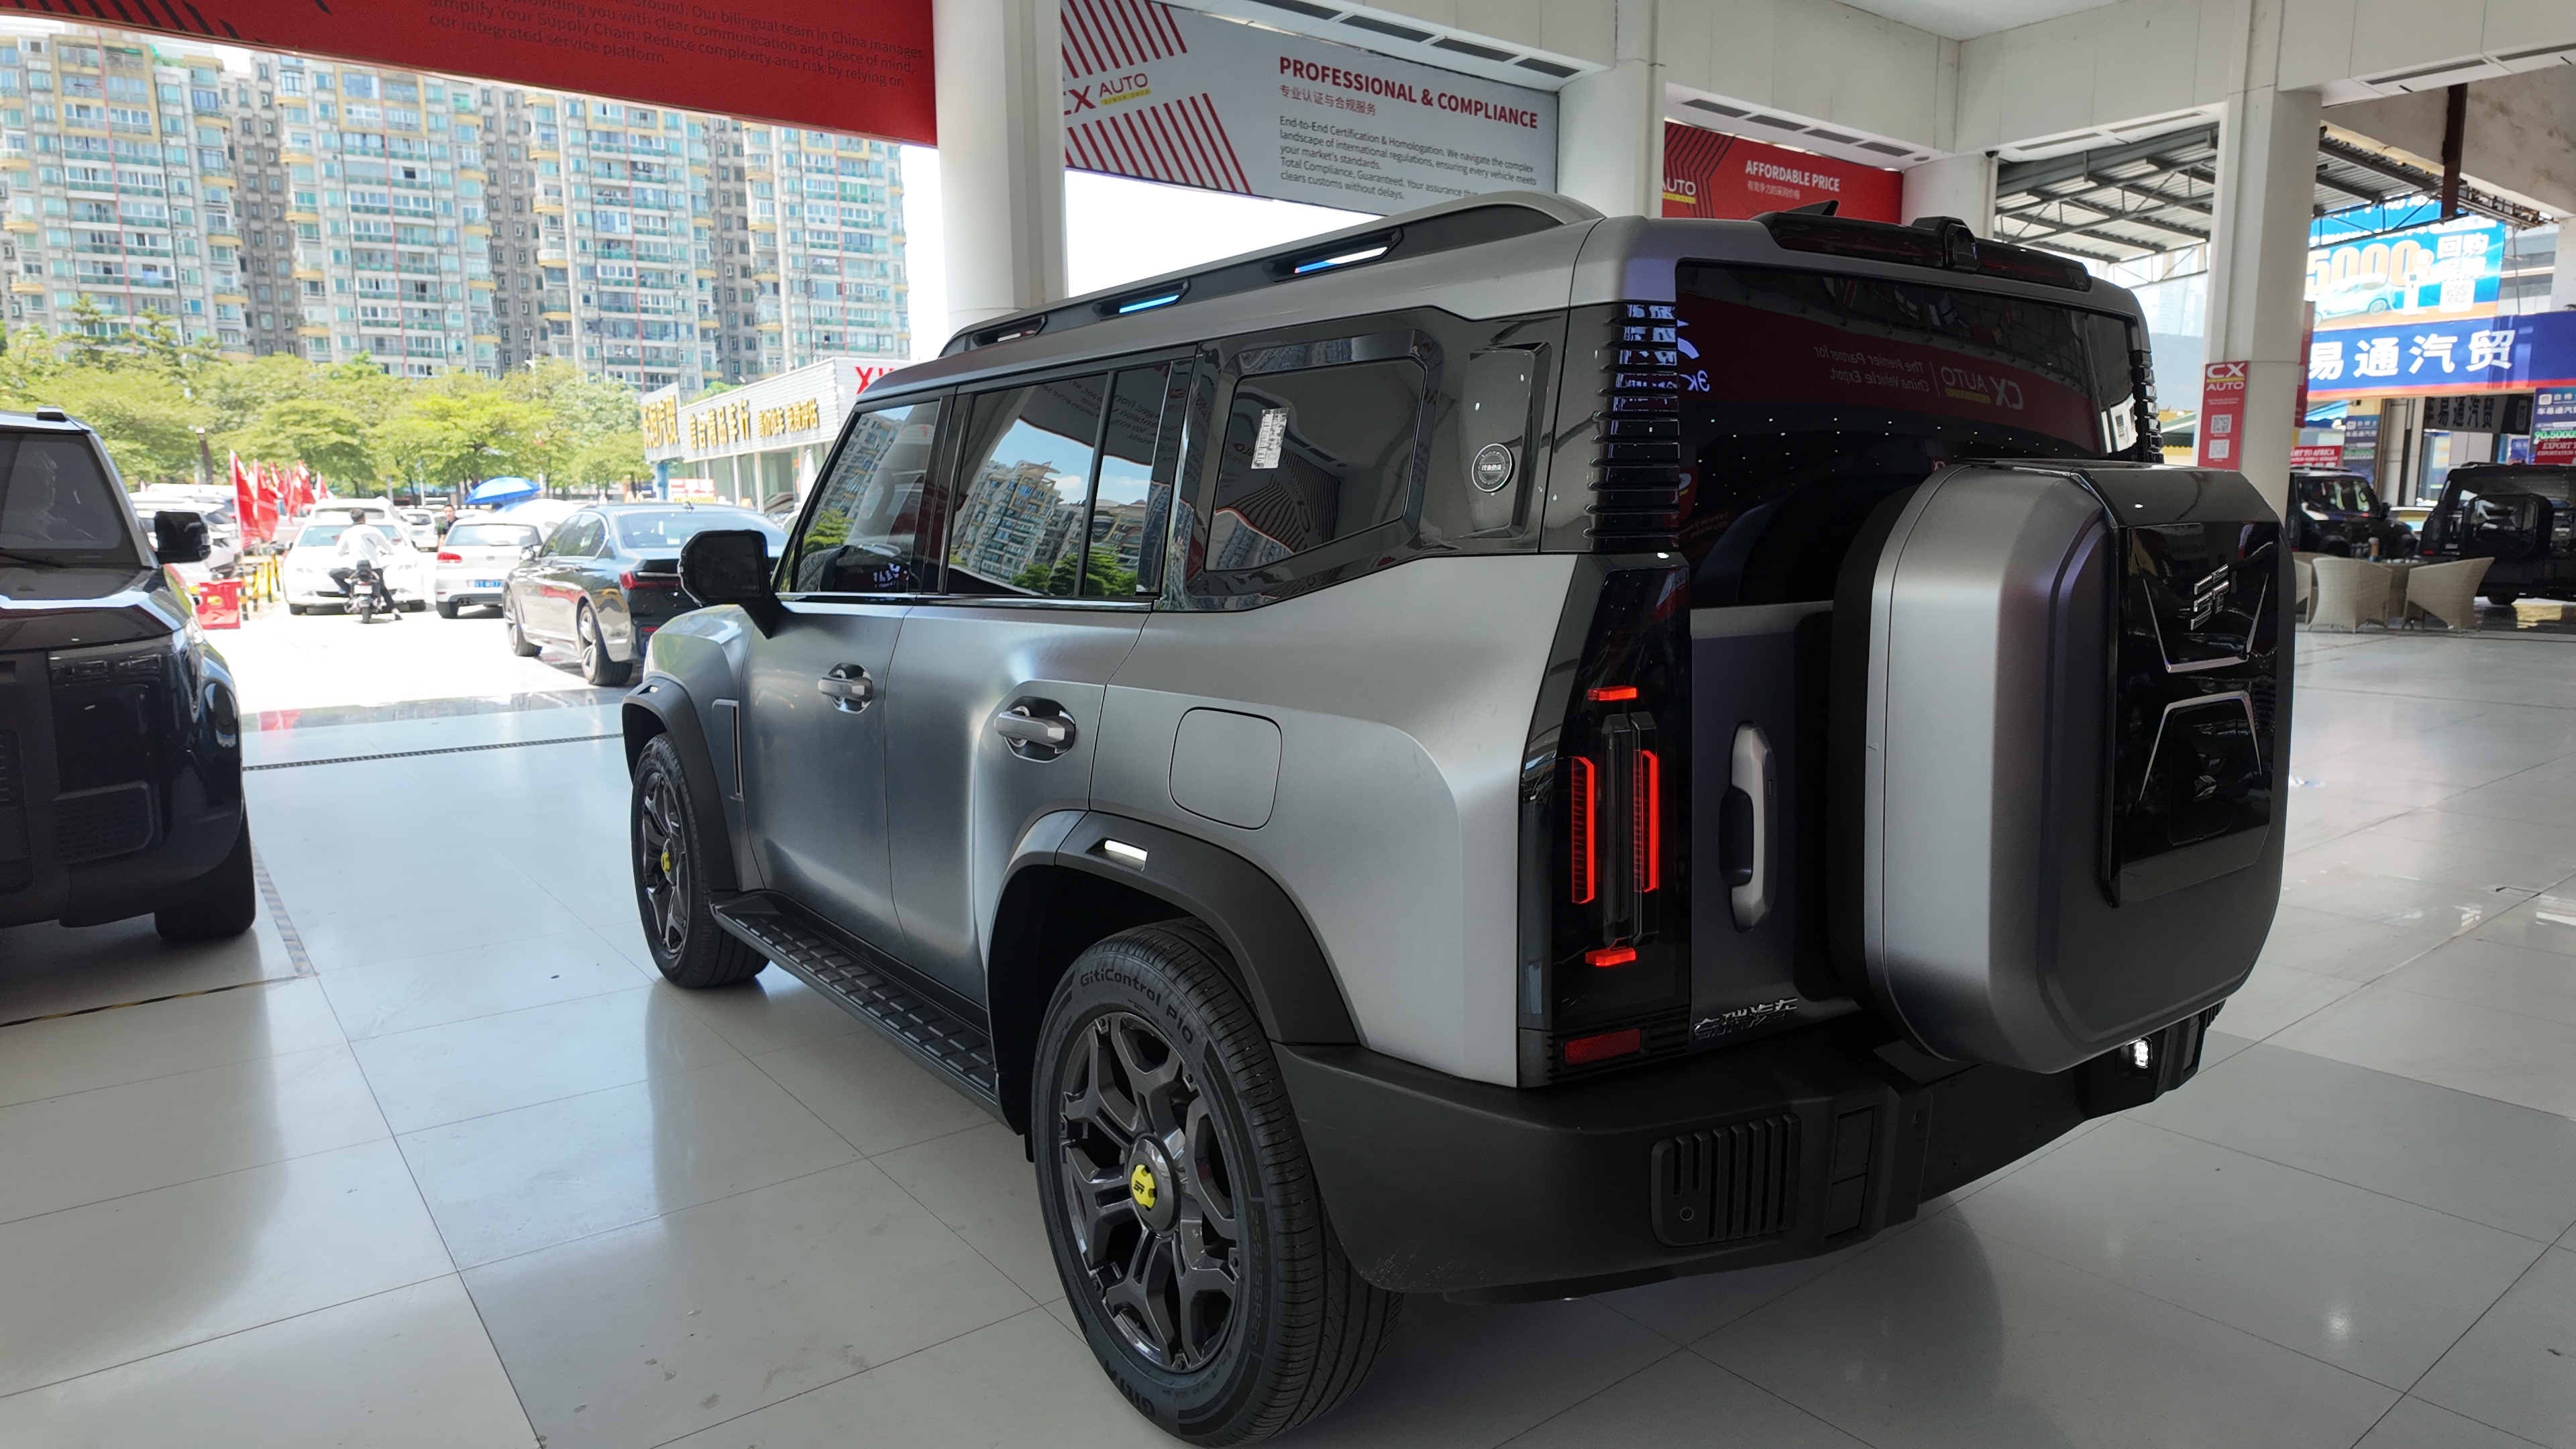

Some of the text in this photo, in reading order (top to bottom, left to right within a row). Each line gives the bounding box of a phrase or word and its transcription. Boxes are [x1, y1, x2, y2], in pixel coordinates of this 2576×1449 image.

[429, 16, 669, 65] our integrated service platform.
[498, 5, 533, 23] Your
[537, 13, 590, 35] Supply
[594, 22, 638, 42] Chain.
[643, 30, 696, 52] Reduce
[698, 44, 771, 66] complexity
[775, 54, 799, 69] and
[802, 58, 824, 74] risk
[827, 61, 841, 78] by
[846, 68, 888, 88] relying
[889, 75, 905, 87] on
[590, 8, 616, 21] you
[619, 11, 651, 26] with
[655, 15, 689, 32] clear
[692, 25, 796, 52] communication
[800, 42, 824, 58] and
[828, 50, 863, 64] peace
[866, 52, 879, 66] of
[881, 58, 915, 74] mind.
[692, 5, 716, 21] Our
[721, 11, 778, 32] bilingual
[782, 23, 813, 39] team
[817, 27, 829, 41] in
[832, 31, 867, 48] China
[870, 40, 924, 60] manages
[1098, 72, 1149, 99] AUTO
[1279, 56, 1538, 129] PROFESSIONAL & COMPLIANCE
[1279, 85, 1377, 116] 专业认证与合规服务
[1279, 115, 1534, 174] End-to-End Certification & Homologation. We navigate the complex
[1279, 129, 1537, 186] landscape of international regulations, ensuring every vehicle meets
[1279, 145, 1382, 170] your market's standards.
[1281, 156, 1302, 168] Total
[1303, 160, 1356, 180] Compliance,
[1356, 170, 1405, 188] Guaranteed.
[1407, 179, 1425, 191] Your
[1426, 184, 1462, 197] assurance
[1281, 170, 1405, 201] clears customs without delays.
[1744, 160, 1841, 193] AFFORDABLE PRICE
[2436, 232, 2489, 260] 回购
[2206, 363, 2245, 378] CX
[2308, 329, 2516, 381] 易通汽贸
[2206, 381, 2245, 392] AUTO
[2542, 442, 2571, 450] EXPORT
[1079, 967, 1194, 1046] GitiControl P10
